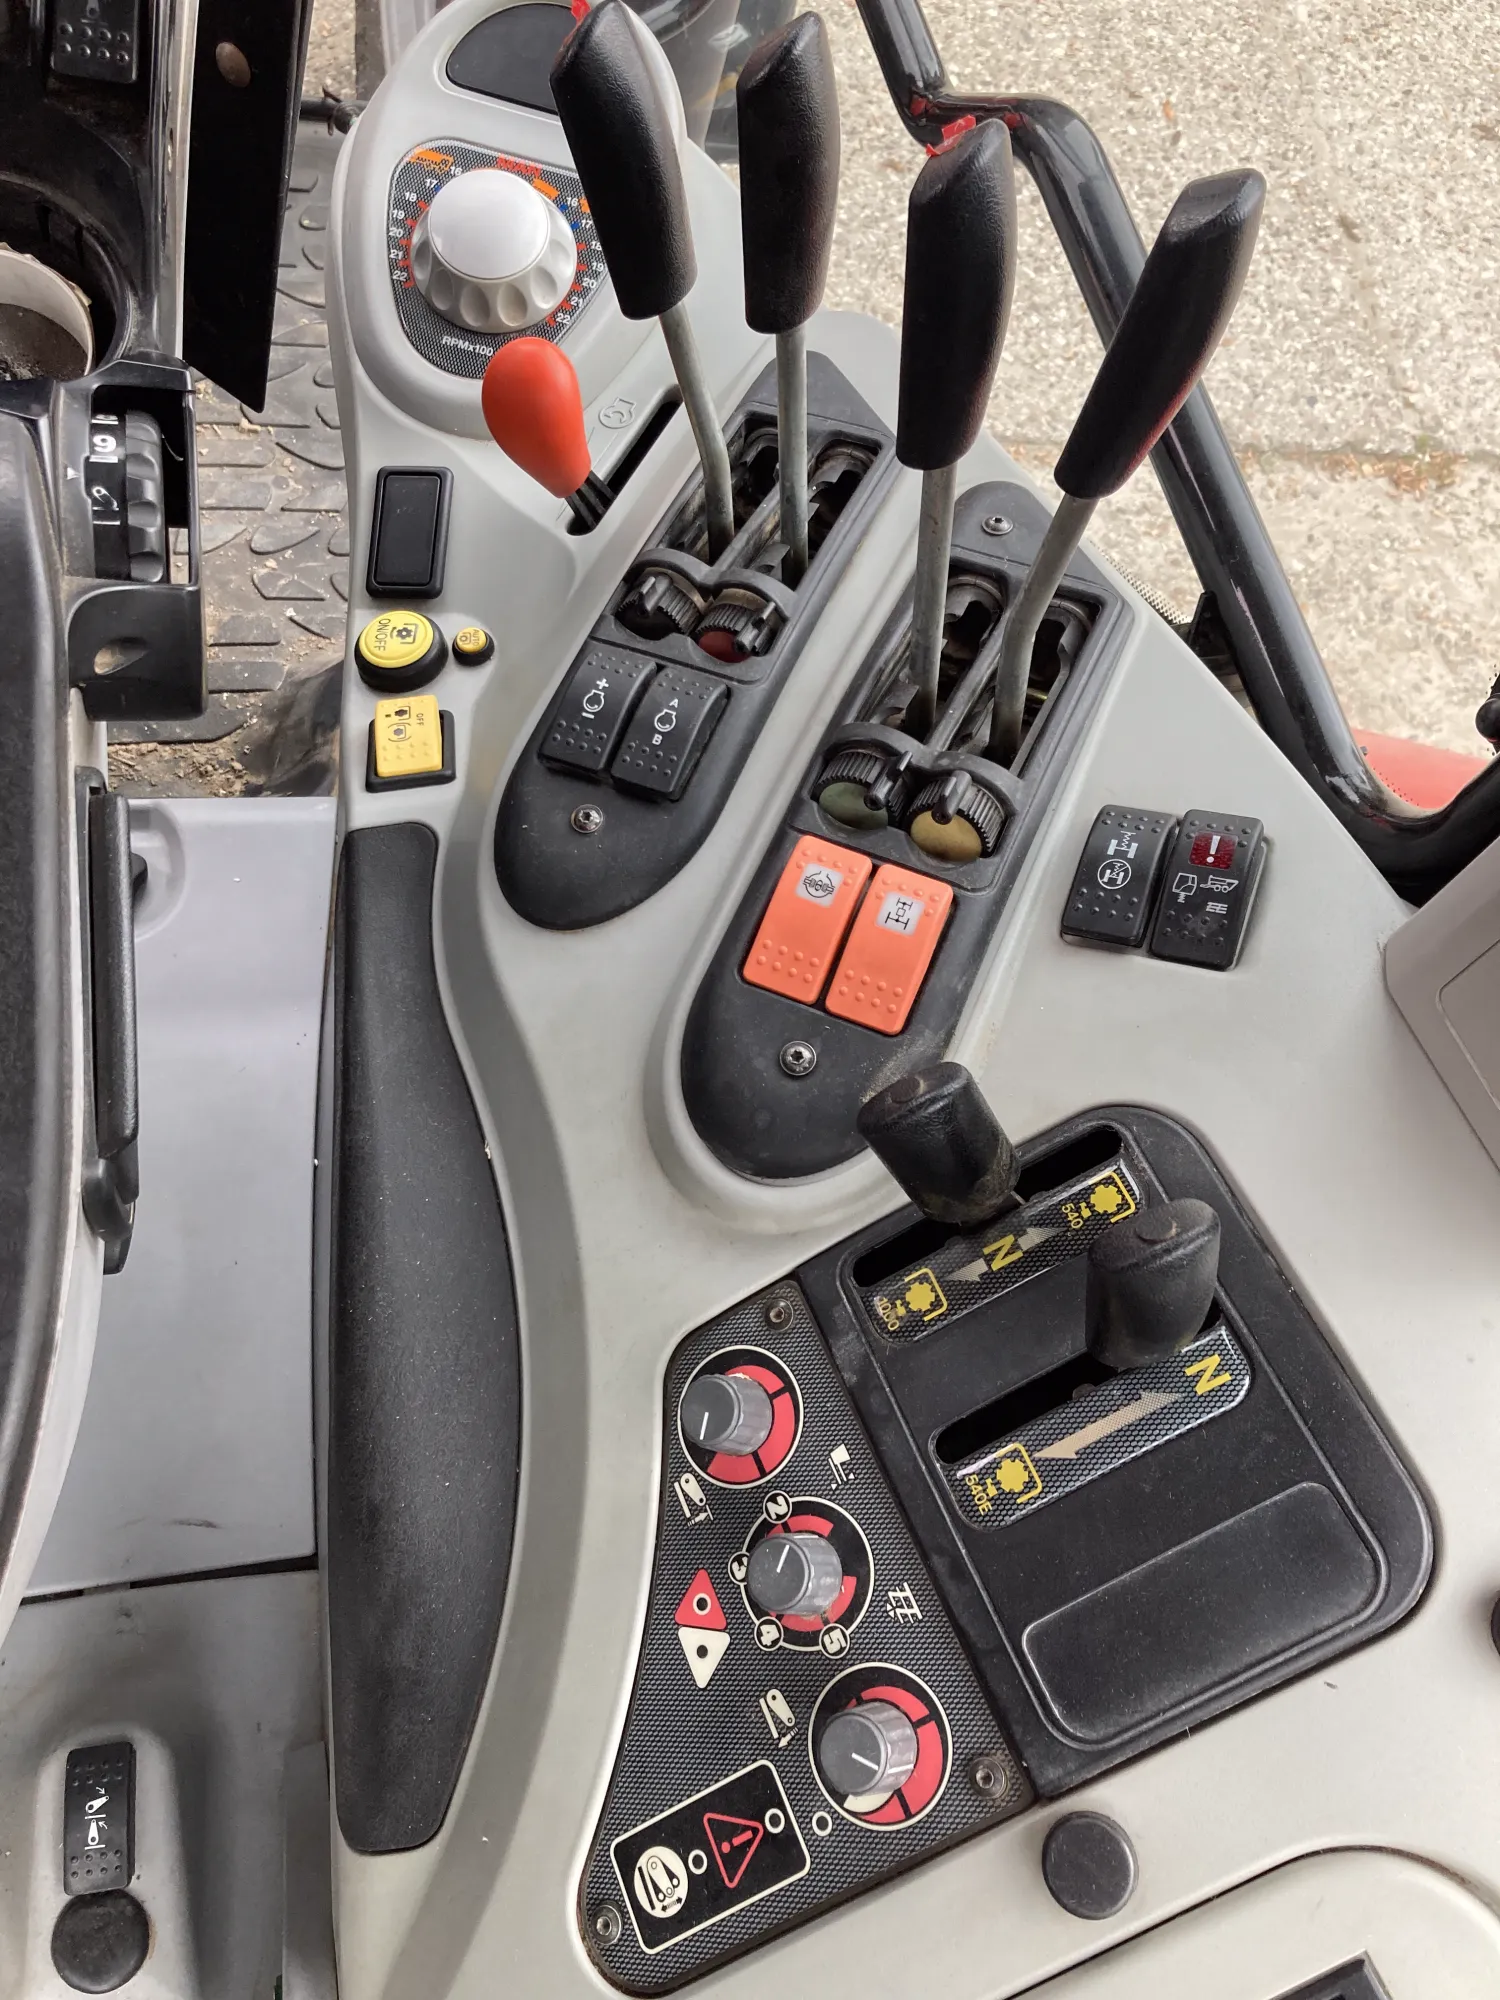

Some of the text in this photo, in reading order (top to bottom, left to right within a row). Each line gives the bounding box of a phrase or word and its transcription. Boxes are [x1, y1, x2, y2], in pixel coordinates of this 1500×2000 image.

[450, 166, 462, 177] 16
[426, 178, 437, 188] 17
[404, 192, 417, 202] 18
[566, 196, 578, 207] 16
[392, 209, 405, 220] 19
[581, 219, 592, 229] 17
[389, 227, 403, 238] 20
[590, 241, 602, 251] 18
[389, 249, 403, 260] 21
[592, 262, 604, 272] 19
[393, 270, 408, 282] 22
[582, 277, 597, 289] 20
[570, 296, 583, 307] 21
[556, 313, 570, 325] 22
[442, 335, 494, 357] RPMx100
[374, 618, 391, 652] ON/OFF
[471, 629, 480, 647] AUTO
[669, 698, 679, 708] A
[416, 713, 424, 726] OFF
[652, 734, 663, 745] B
[1061, 1203, 1083, 1229] 540
[982, 1234, 1024, 1272] N
[876, 1296, 900, 1332] 1000
[1184, 1353, 1232, 1396] N
[965, 1474, 993, 1516] 540E
[765, 1495, 790, 1519] 2
[756, 1623, 780, 1647] 4
[823, 1627, 846, 1654] 5
